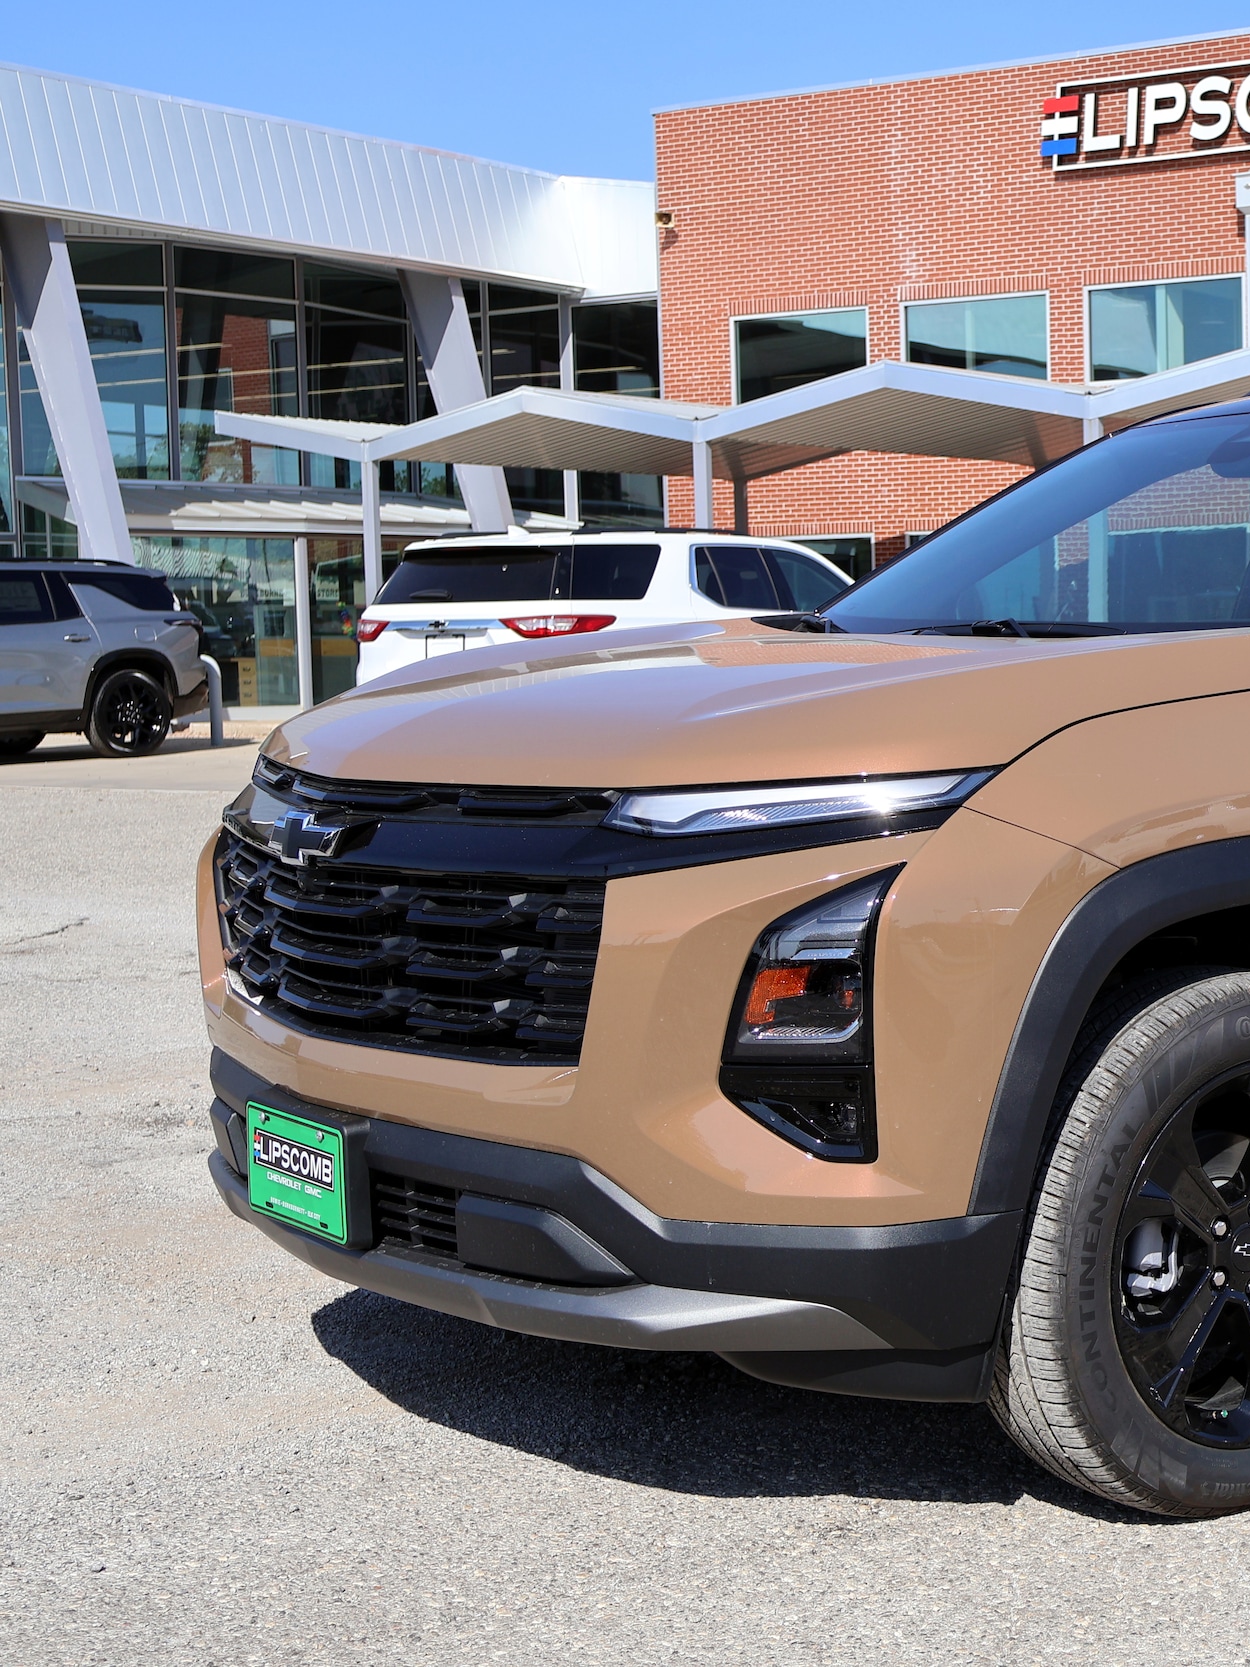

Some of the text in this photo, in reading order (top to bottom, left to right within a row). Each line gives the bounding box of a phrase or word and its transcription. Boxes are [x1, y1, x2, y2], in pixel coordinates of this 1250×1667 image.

[259, 1136, 332, 1184] LIPSCOMB
[266, 1171, 322, 1199] CHEVROLET GMC
